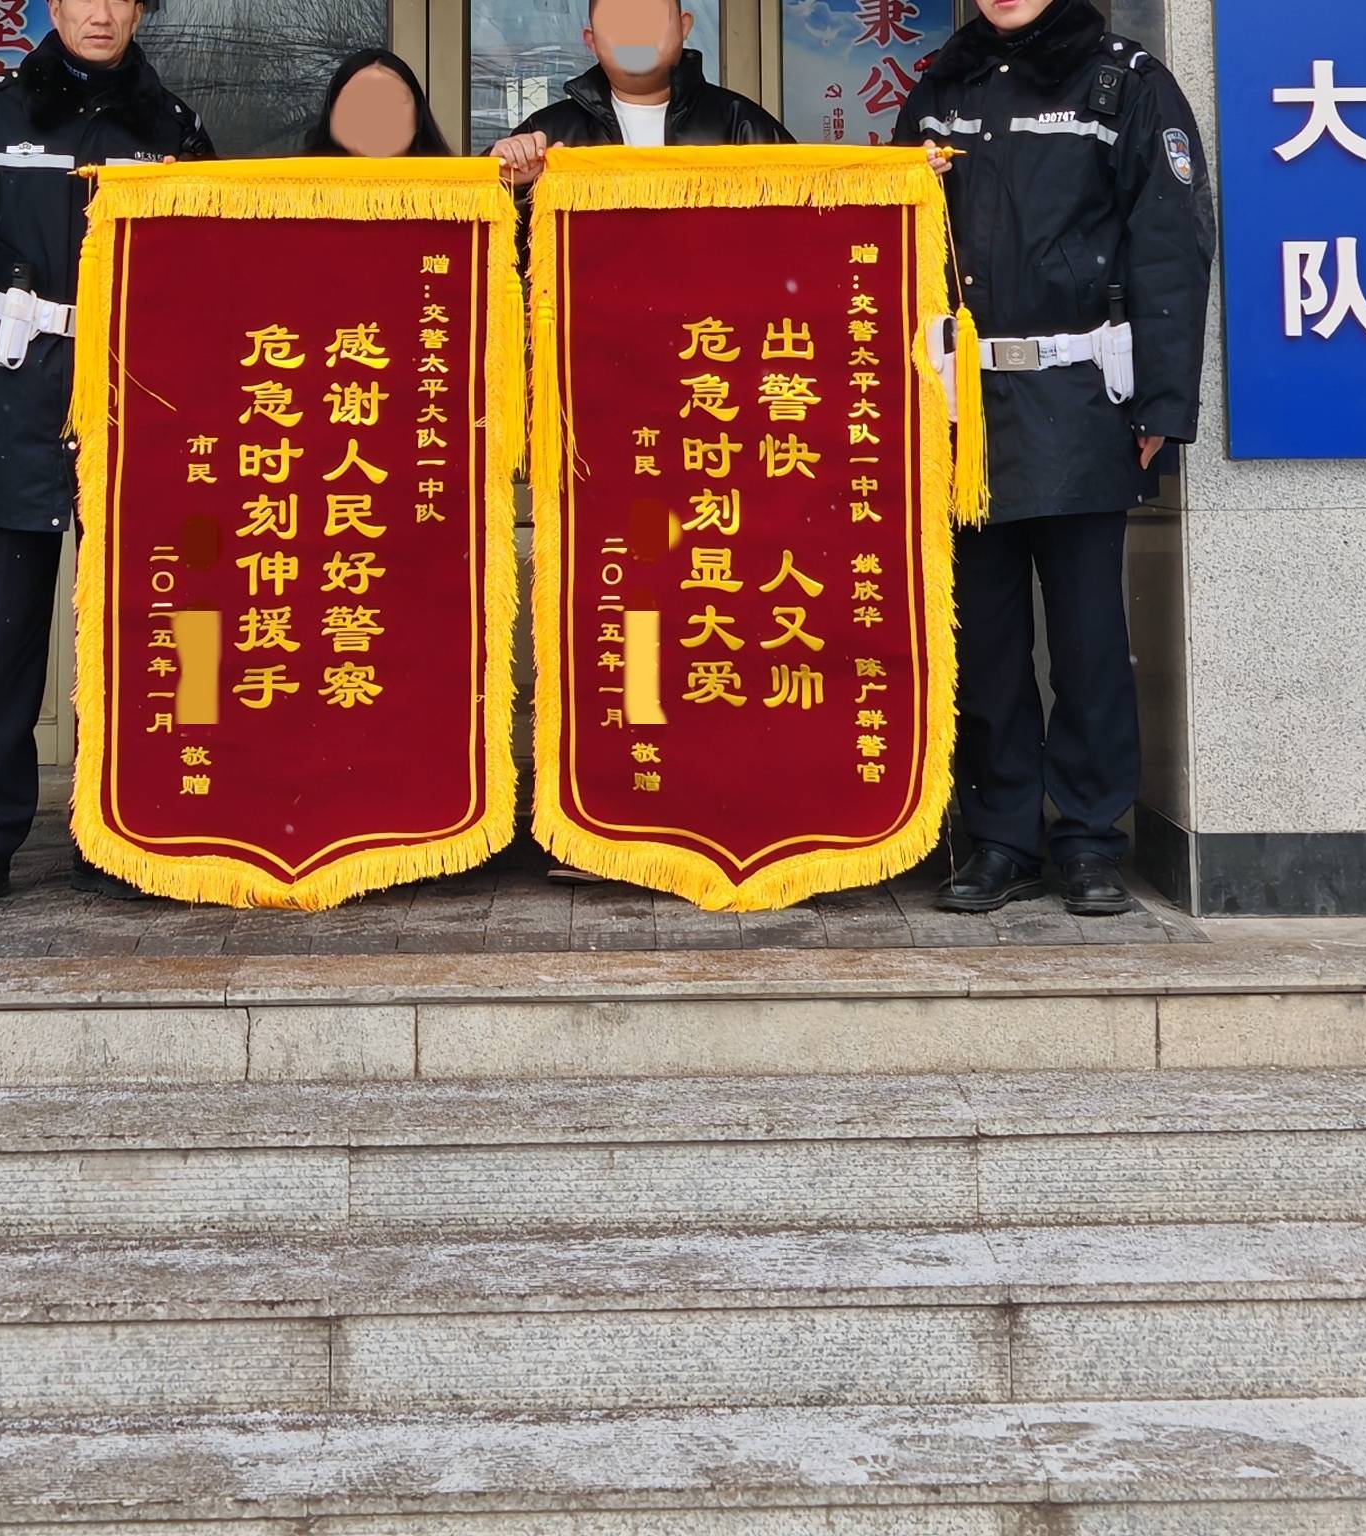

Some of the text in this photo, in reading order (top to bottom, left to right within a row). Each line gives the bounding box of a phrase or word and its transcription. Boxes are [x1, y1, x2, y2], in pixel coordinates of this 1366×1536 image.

[180, 433, 220, 795] 市民 敬赠
[231, 322, 306, 711] 危急时刻伸援手
[316, 321, 390, 710] 感谢人民好警察
[630, 425, 663, 792] 市民 敬赠
[678, 316, 748, 709] 危急时刻显大爱
[757, 316, 826, 711] 出警快 人又帅
